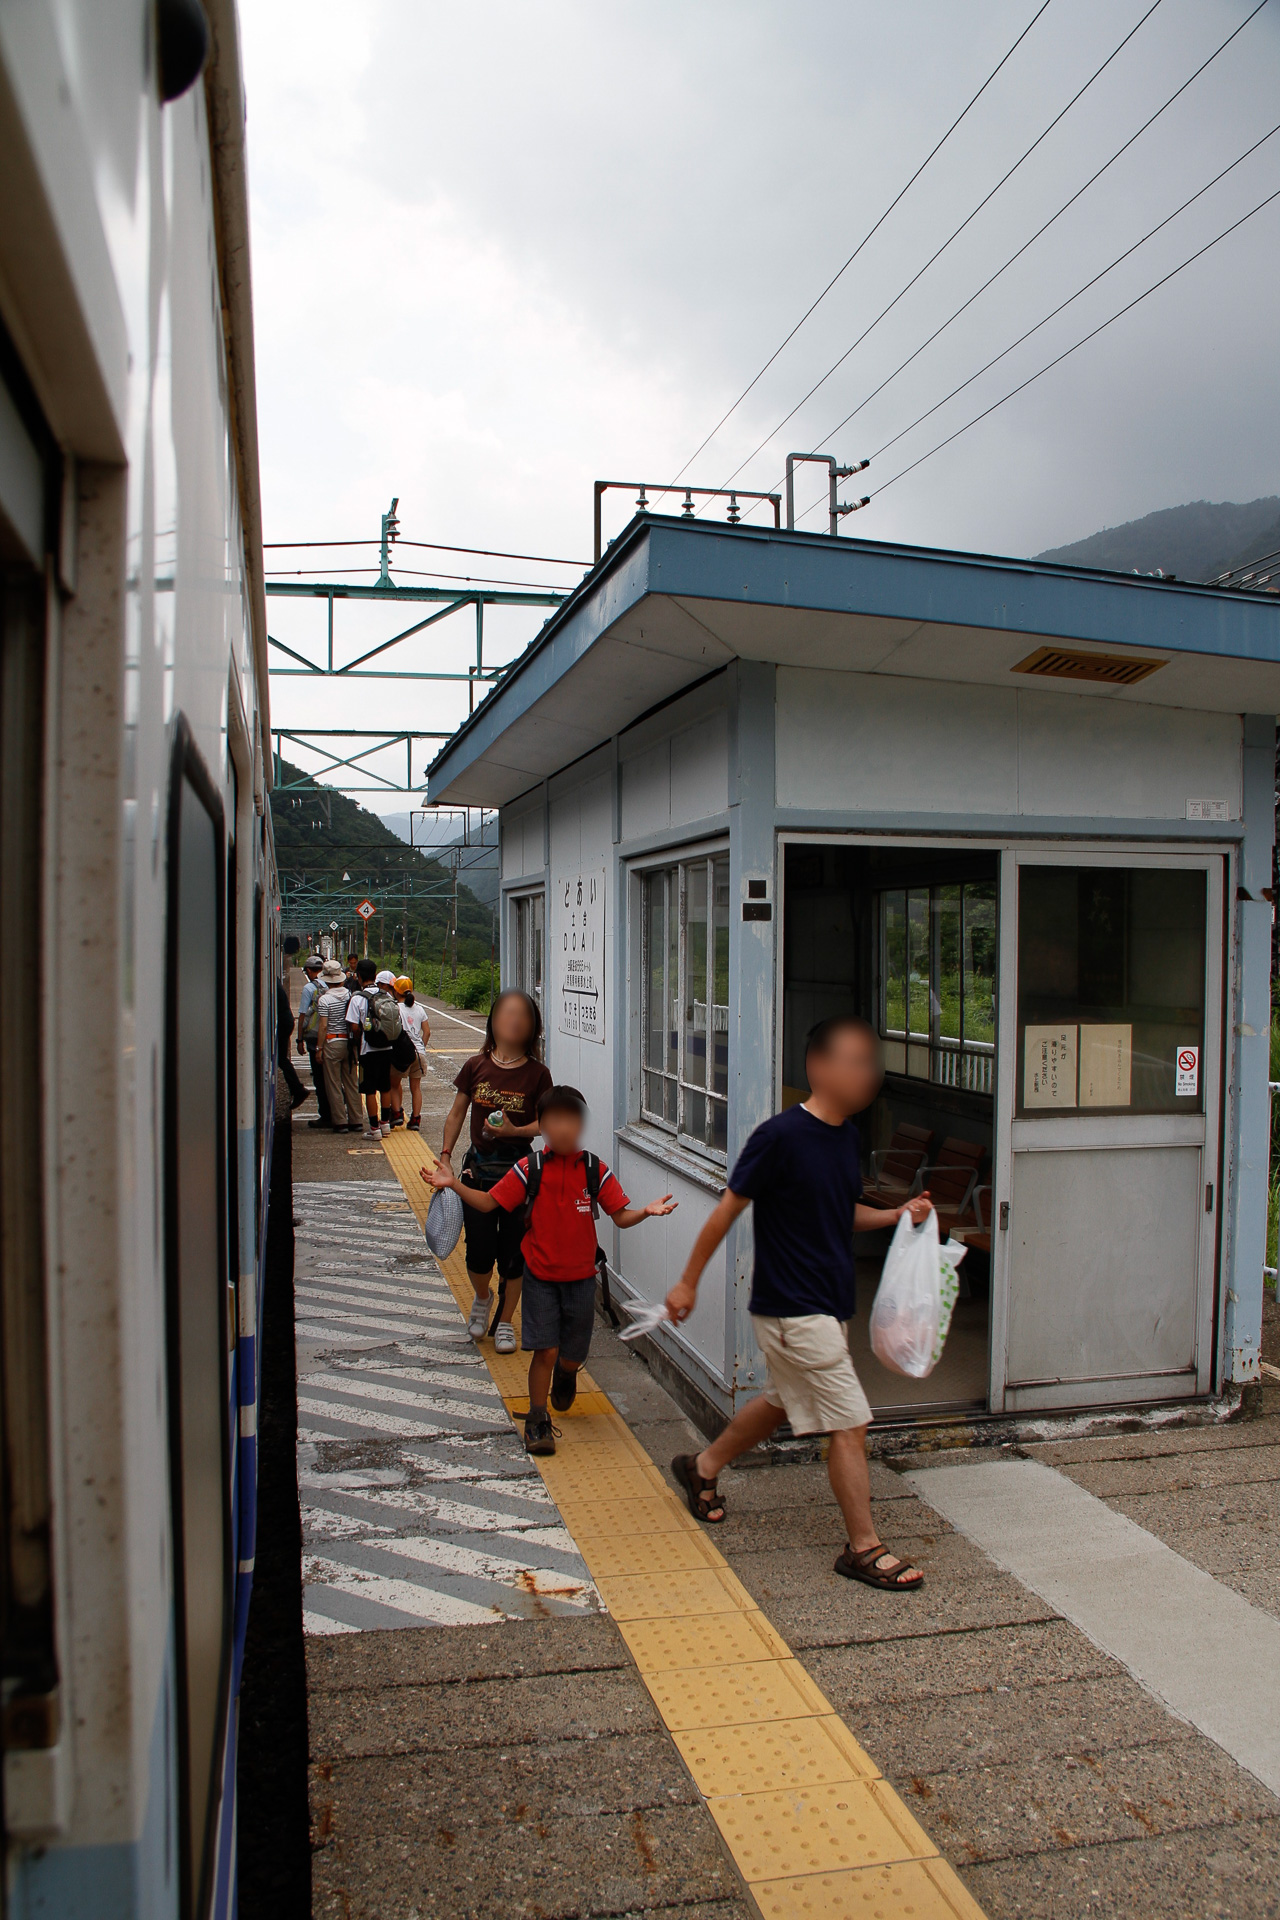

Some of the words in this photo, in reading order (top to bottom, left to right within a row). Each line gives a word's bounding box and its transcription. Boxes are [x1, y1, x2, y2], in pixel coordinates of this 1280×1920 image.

[565, 878, 597, 908] どあい
[571, 911, 587, 927] 土合
[564, 931, 595, 952] DOAI
[1050, 1040, 1058, 1097] 滑りやすいので
